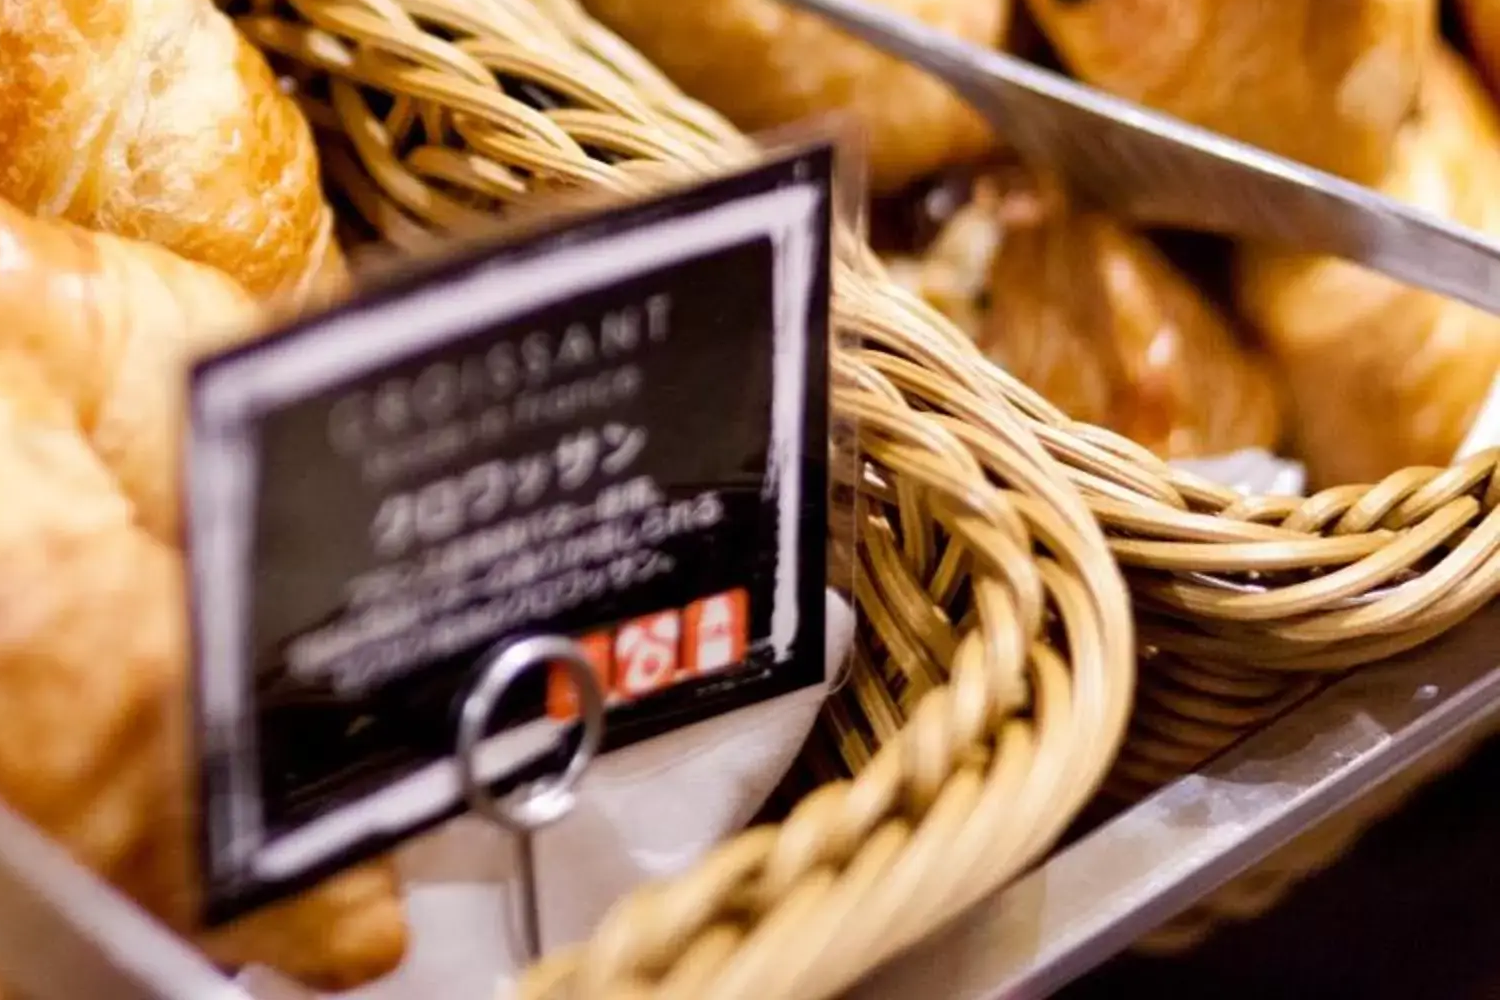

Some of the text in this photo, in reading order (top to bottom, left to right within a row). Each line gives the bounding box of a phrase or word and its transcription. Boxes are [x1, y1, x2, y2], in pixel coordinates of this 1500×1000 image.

[329, 293, 671, 452] CROISSANT
[370, 422, 647, 554] クロワッサン
